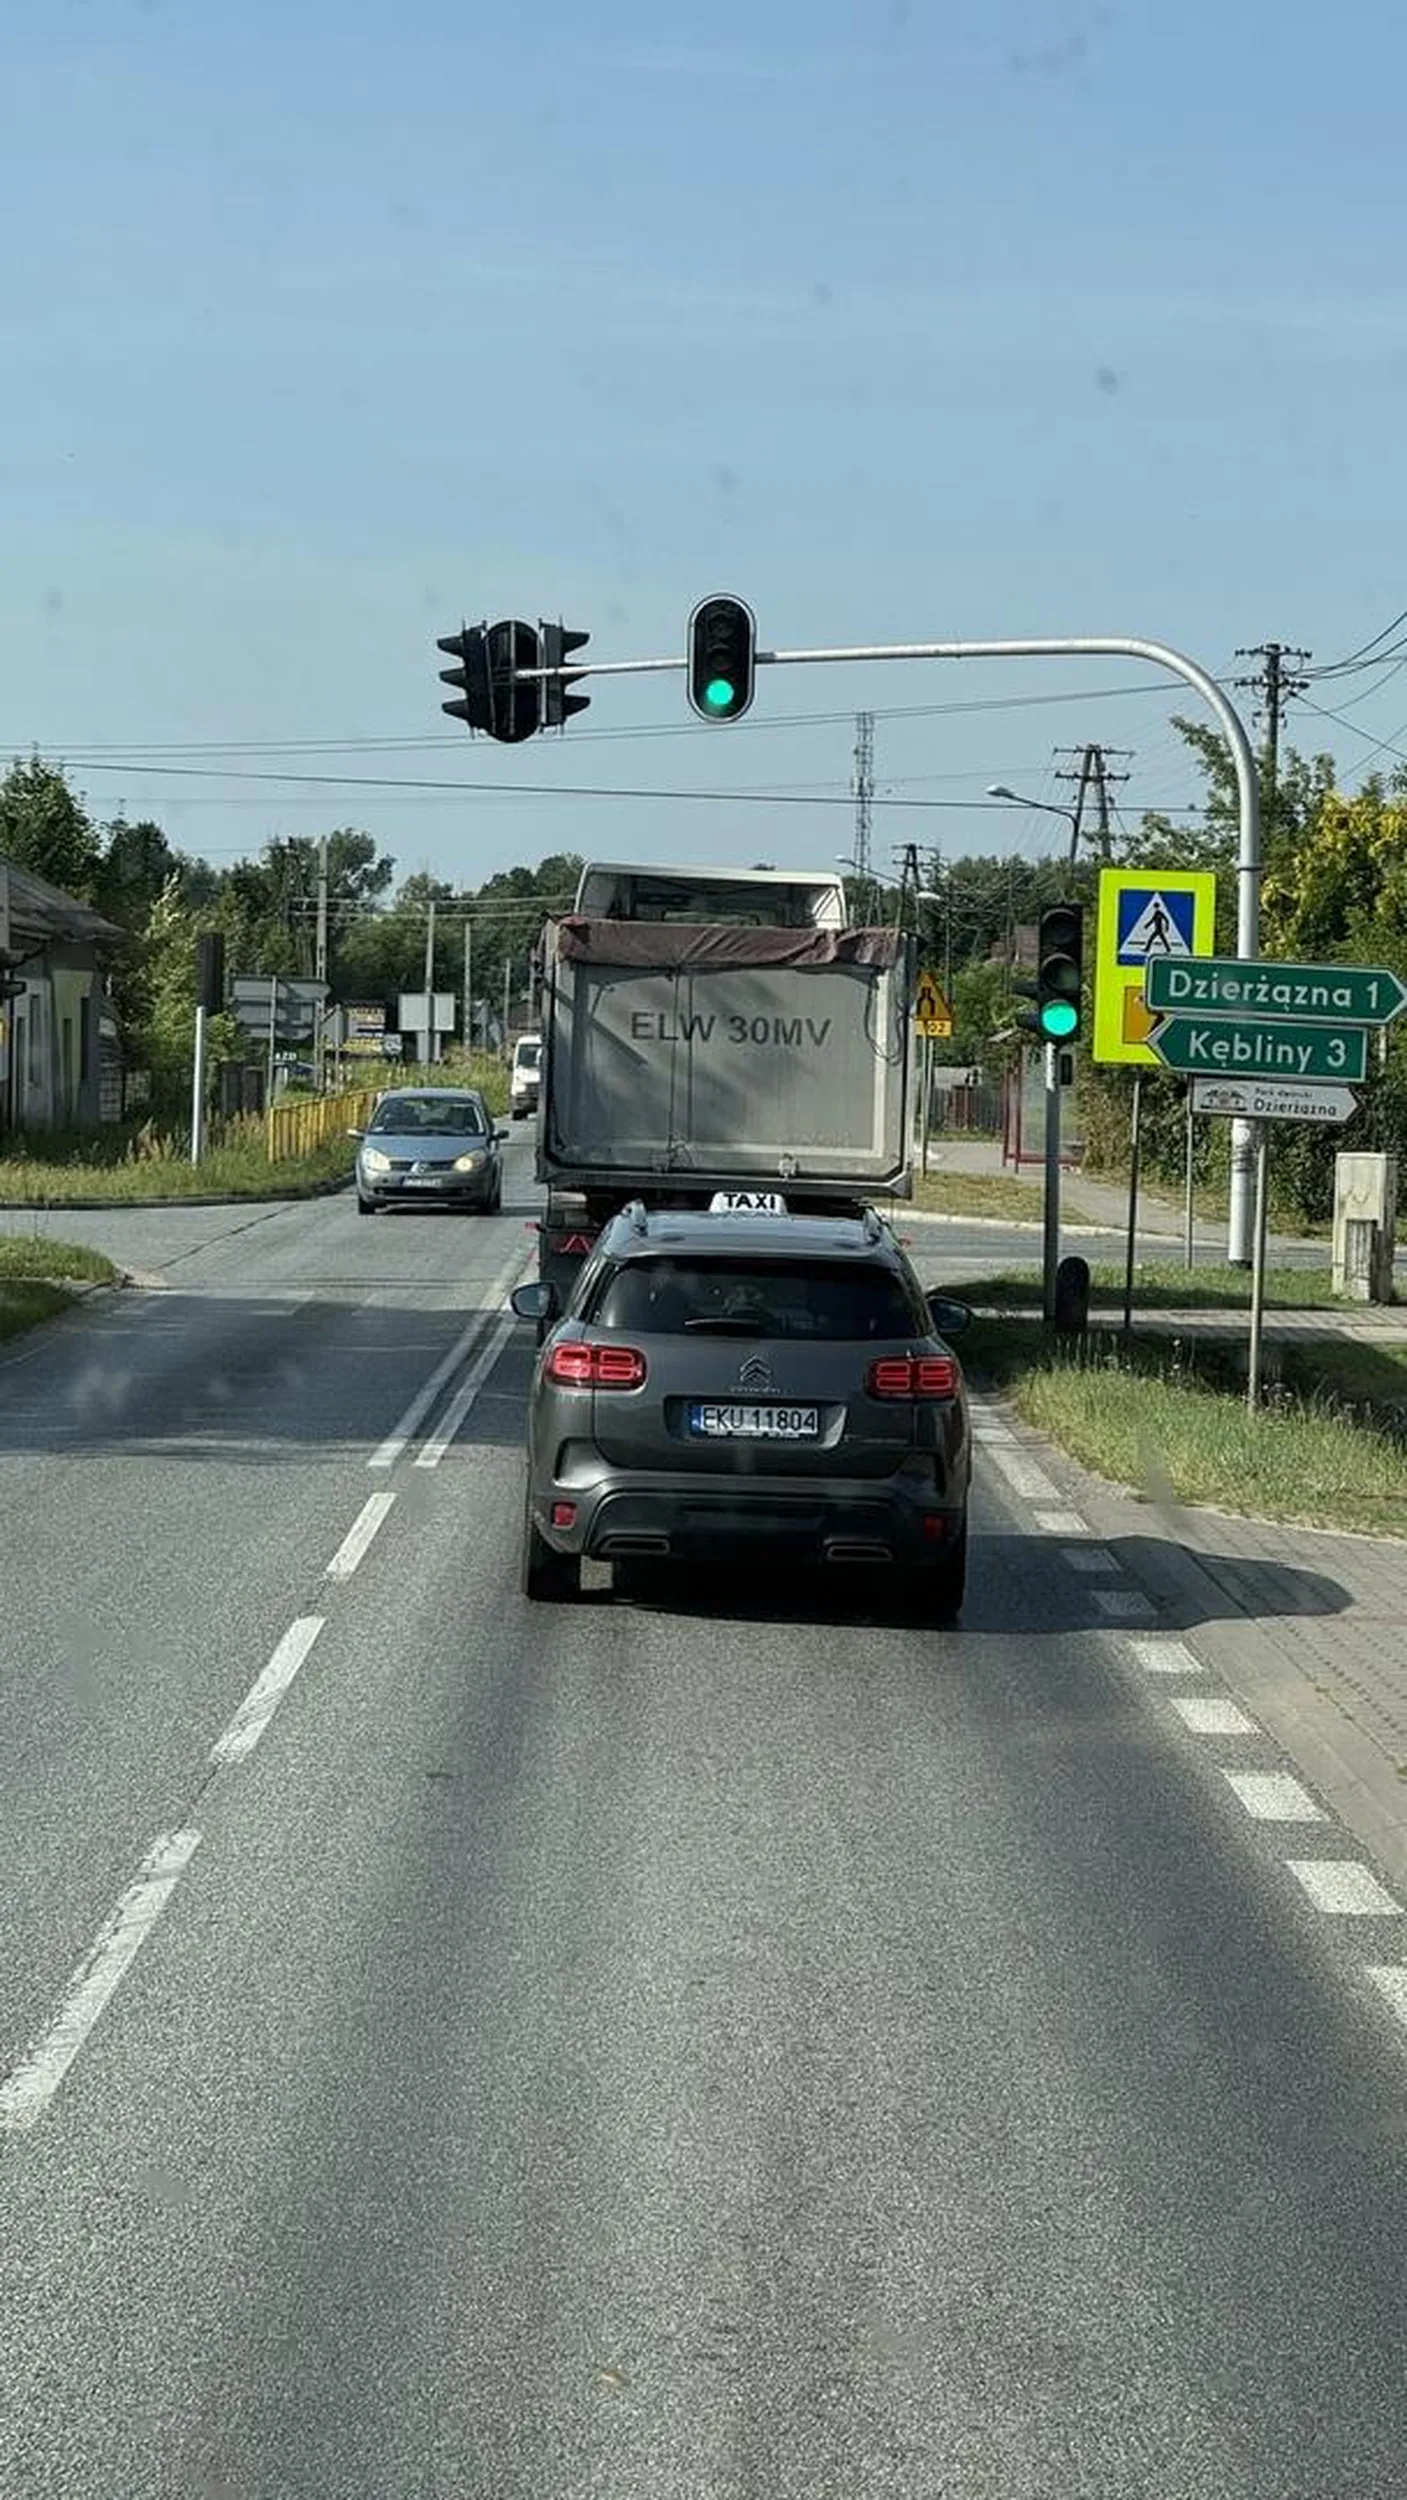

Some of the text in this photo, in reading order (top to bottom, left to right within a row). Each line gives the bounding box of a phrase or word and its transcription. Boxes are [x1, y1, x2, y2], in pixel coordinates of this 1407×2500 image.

[1168, 969, 1379, 1012] Dzierżązna 1
[631, 1012, 832, 1046] ELW 30MV
[1188, 1029, 1347, 1073] Kębliny 3
[723, 1193, 775, 1210] TAXI
[703, 1407, 816, 1431] EKU 11804
